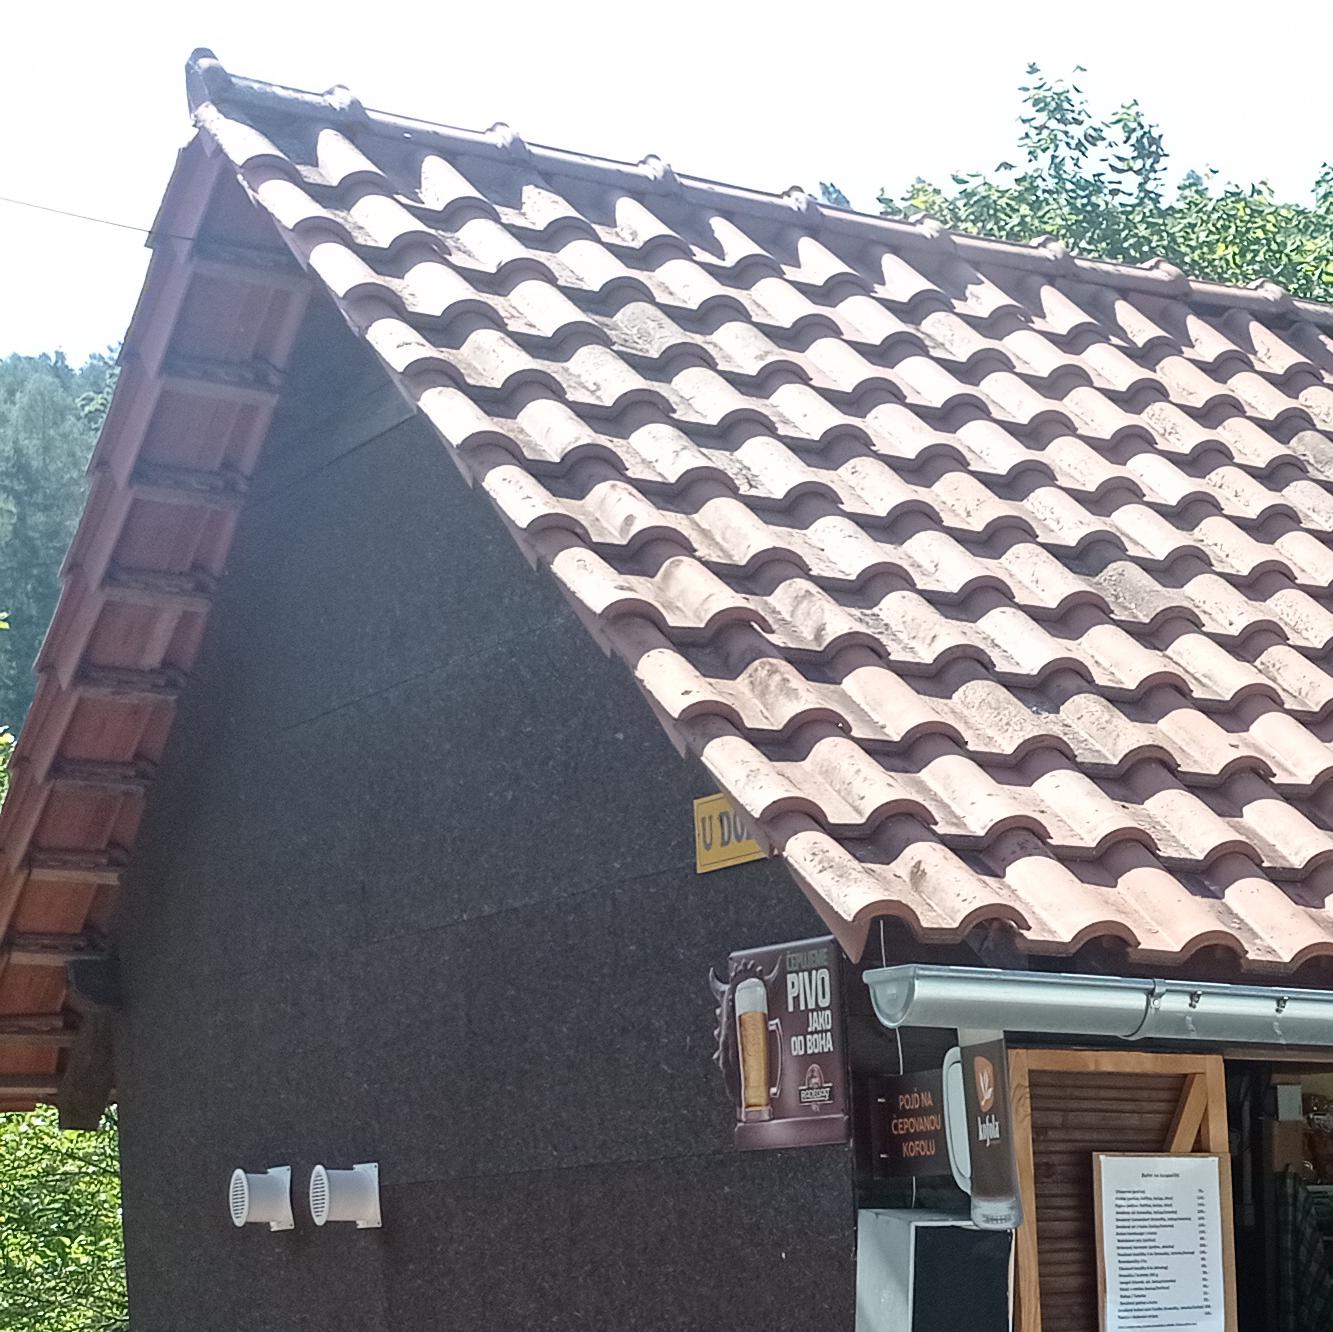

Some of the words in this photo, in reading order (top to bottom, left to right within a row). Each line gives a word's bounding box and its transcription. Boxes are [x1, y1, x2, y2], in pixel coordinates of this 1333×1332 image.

[701, 814, 713, 851] U
[786, 968, 831, 1012] PIVO
[808, 1010, 832, 1032] JAKO
[790, 1035, 804, 1056] OD
[806, 1032, 834, 1055] BOHA
[921, 1091, 934, 1107] NA
[891, 1114, 941, 1135] ČEPOVANOU
[977, 1114, 1000, 1147] kofola
[902, 1141, 936, 1158] KOFOLU
